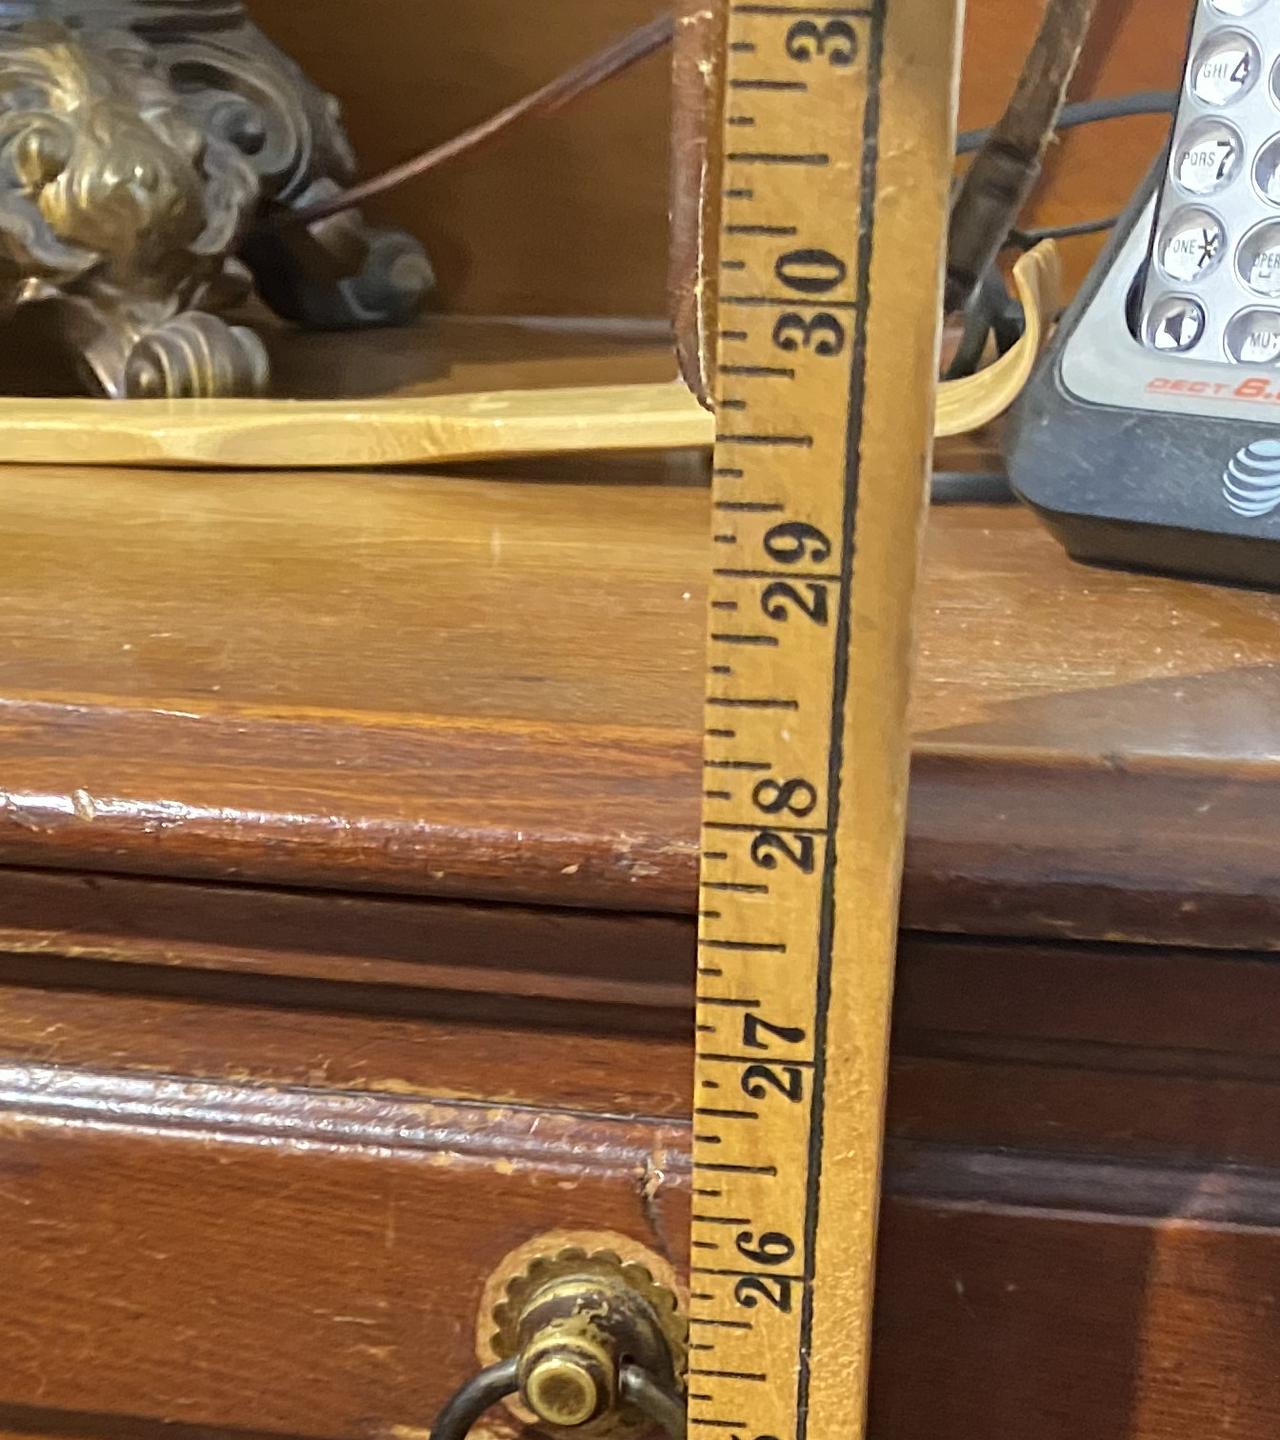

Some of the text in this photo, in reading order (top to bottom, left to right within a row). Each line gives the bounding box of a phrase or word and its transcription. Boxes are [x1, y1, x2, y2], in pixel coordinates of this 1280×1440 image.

[785, 19, 858, 66] 3
[1230, 52, 1250, 85] 4
[1215, 140, 1235, 181] 7
[772, 248, 847, 357] 30
[1146, 377, 1231, 396] DECT
[760, 520, 833, 627] 29
[750, 776, 818, 875] 28
[740, 1012, 806, 1104] 27
[734, 1230, 796, 1315] 26
